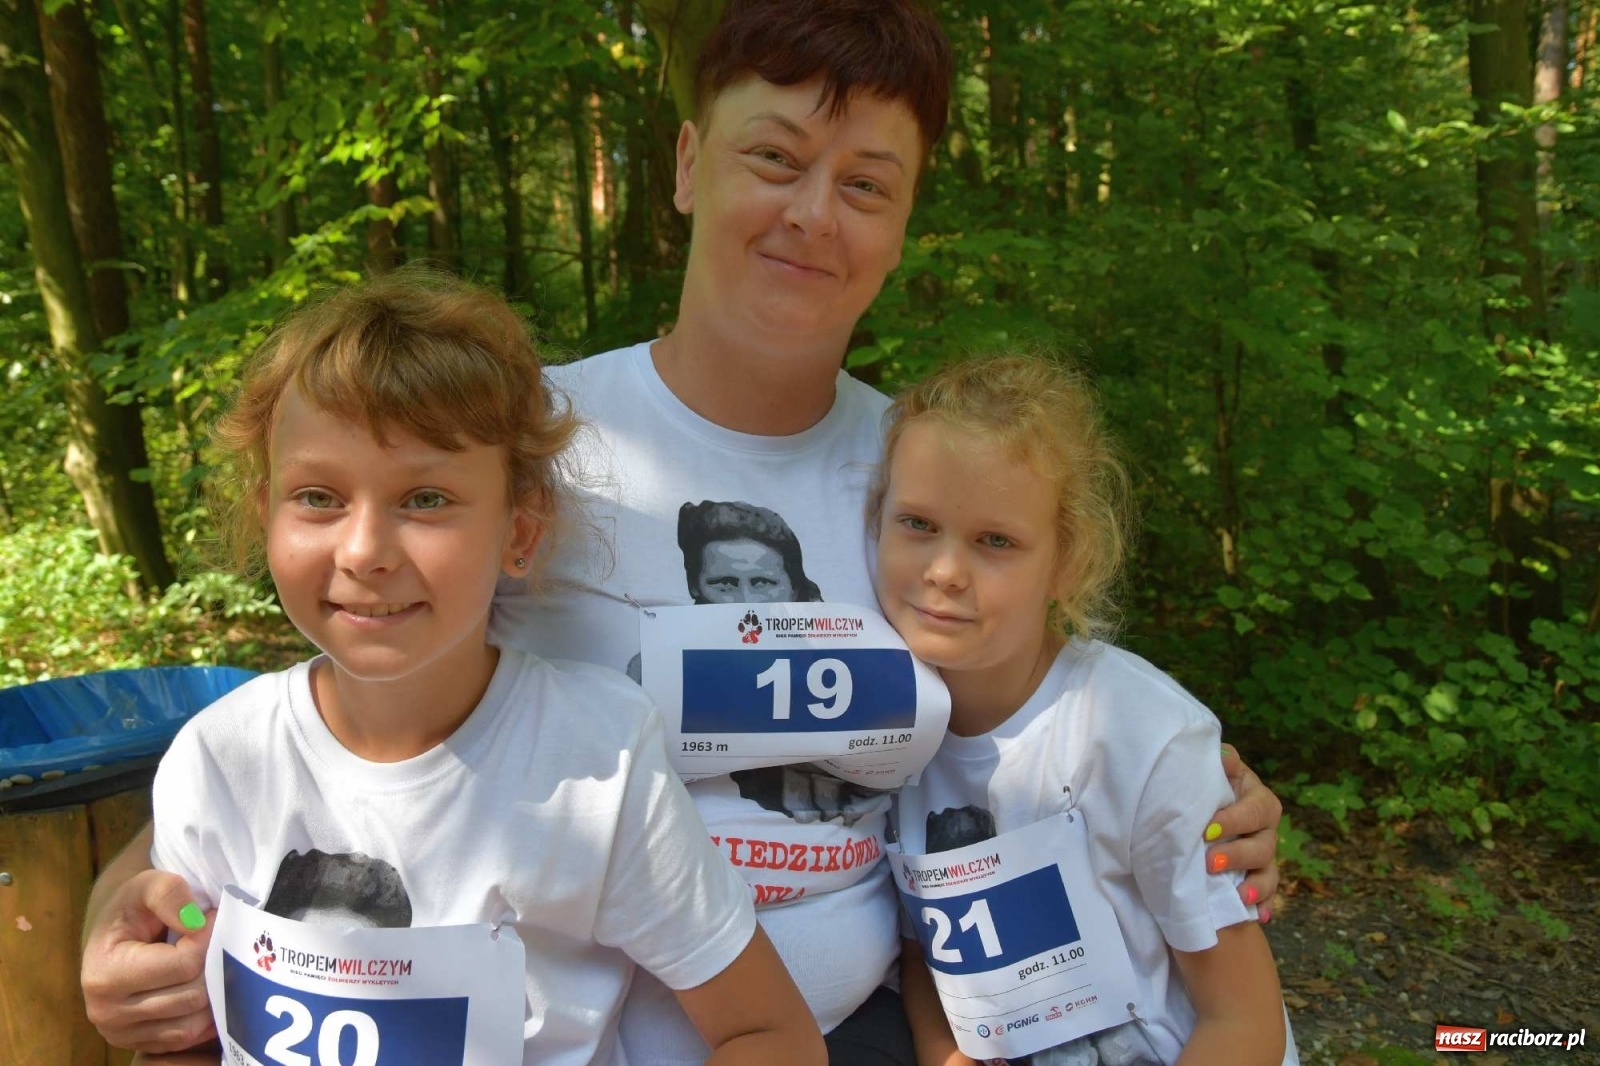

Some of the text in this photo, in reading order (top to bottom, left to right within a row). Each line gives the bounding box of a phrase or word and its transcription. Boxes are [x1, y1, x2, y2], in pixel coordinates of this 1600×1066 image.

[764, 617, 864, 631] TROPEMWILCZYM
[756, 657, 853, 720] 19
[681, 733, 912, 752] 1963 m godz. 11.00
[710, 833, 880, 873] IEDZIKÓWNA
[912, 853, 1001, 882] TROPEMWILCZYM
[920, 898, 1003, 963] 21
[280, 947, 412, 976] TROPEMWILCZYM
[1018, 946, 1085, 980] godz. 11.00
[264, 995, 380, 1066] 20
[1006, 1014, 1040, 1032] PGNiG
